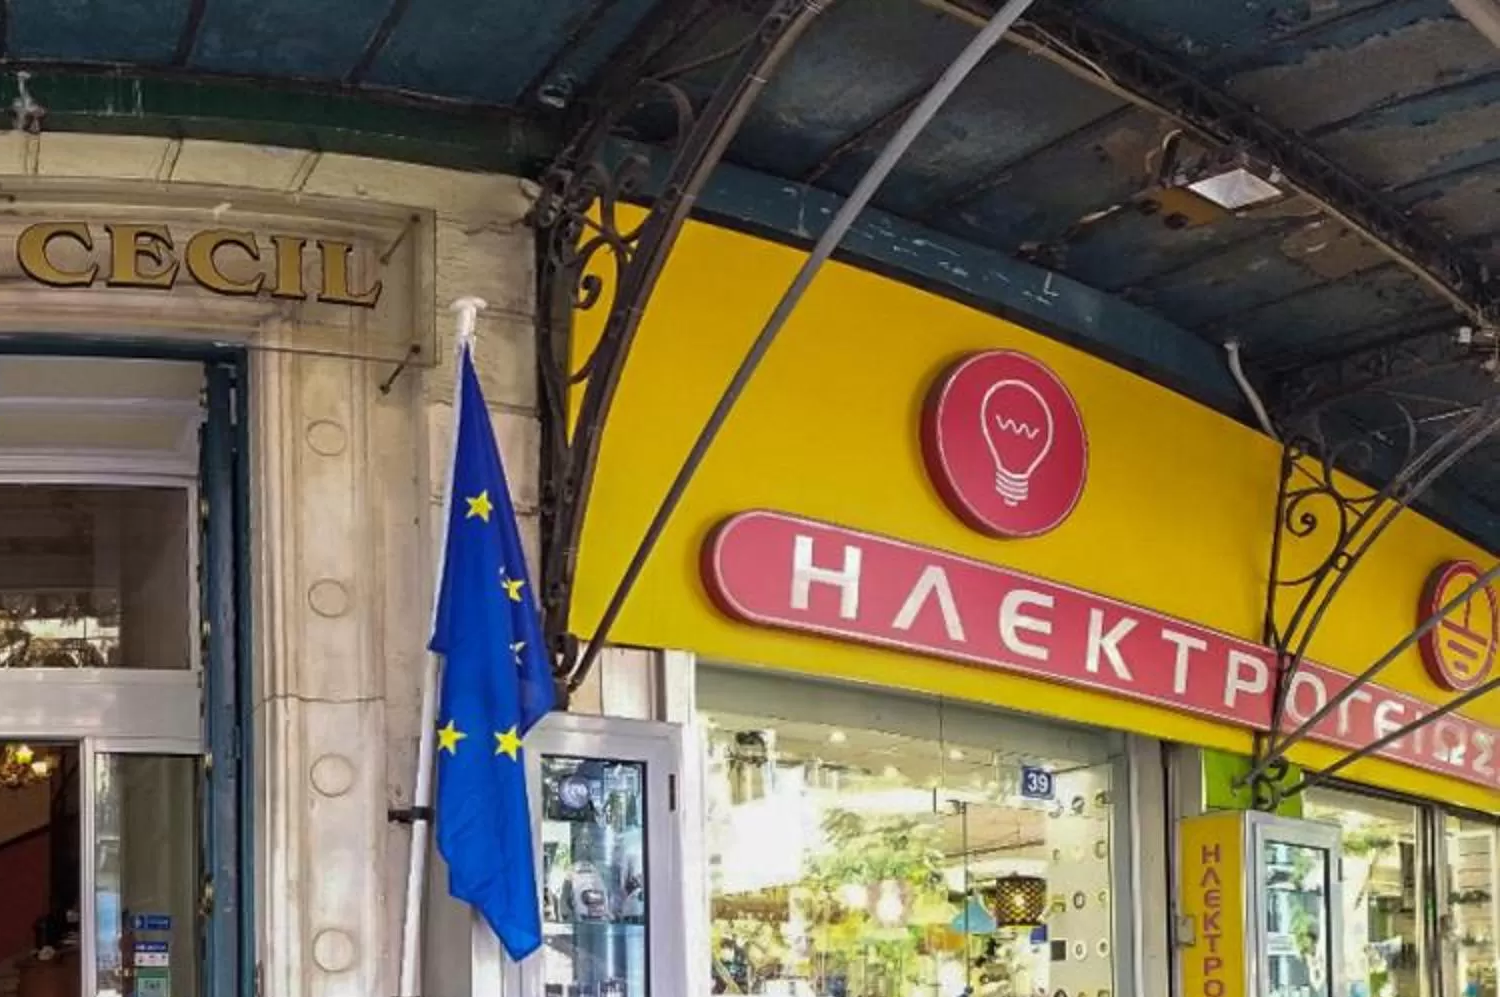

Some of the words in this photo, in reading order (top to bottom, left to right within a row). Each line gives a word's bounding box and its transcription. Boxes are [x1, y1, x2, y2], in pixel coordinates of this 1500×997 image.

[15, 220, 384, 309] CECIL
[790, 534, 1500, 786] ΗΛΕΚΤΡΟΓΕΙΩΣ
[1026, 771, 1050, 794] 39
